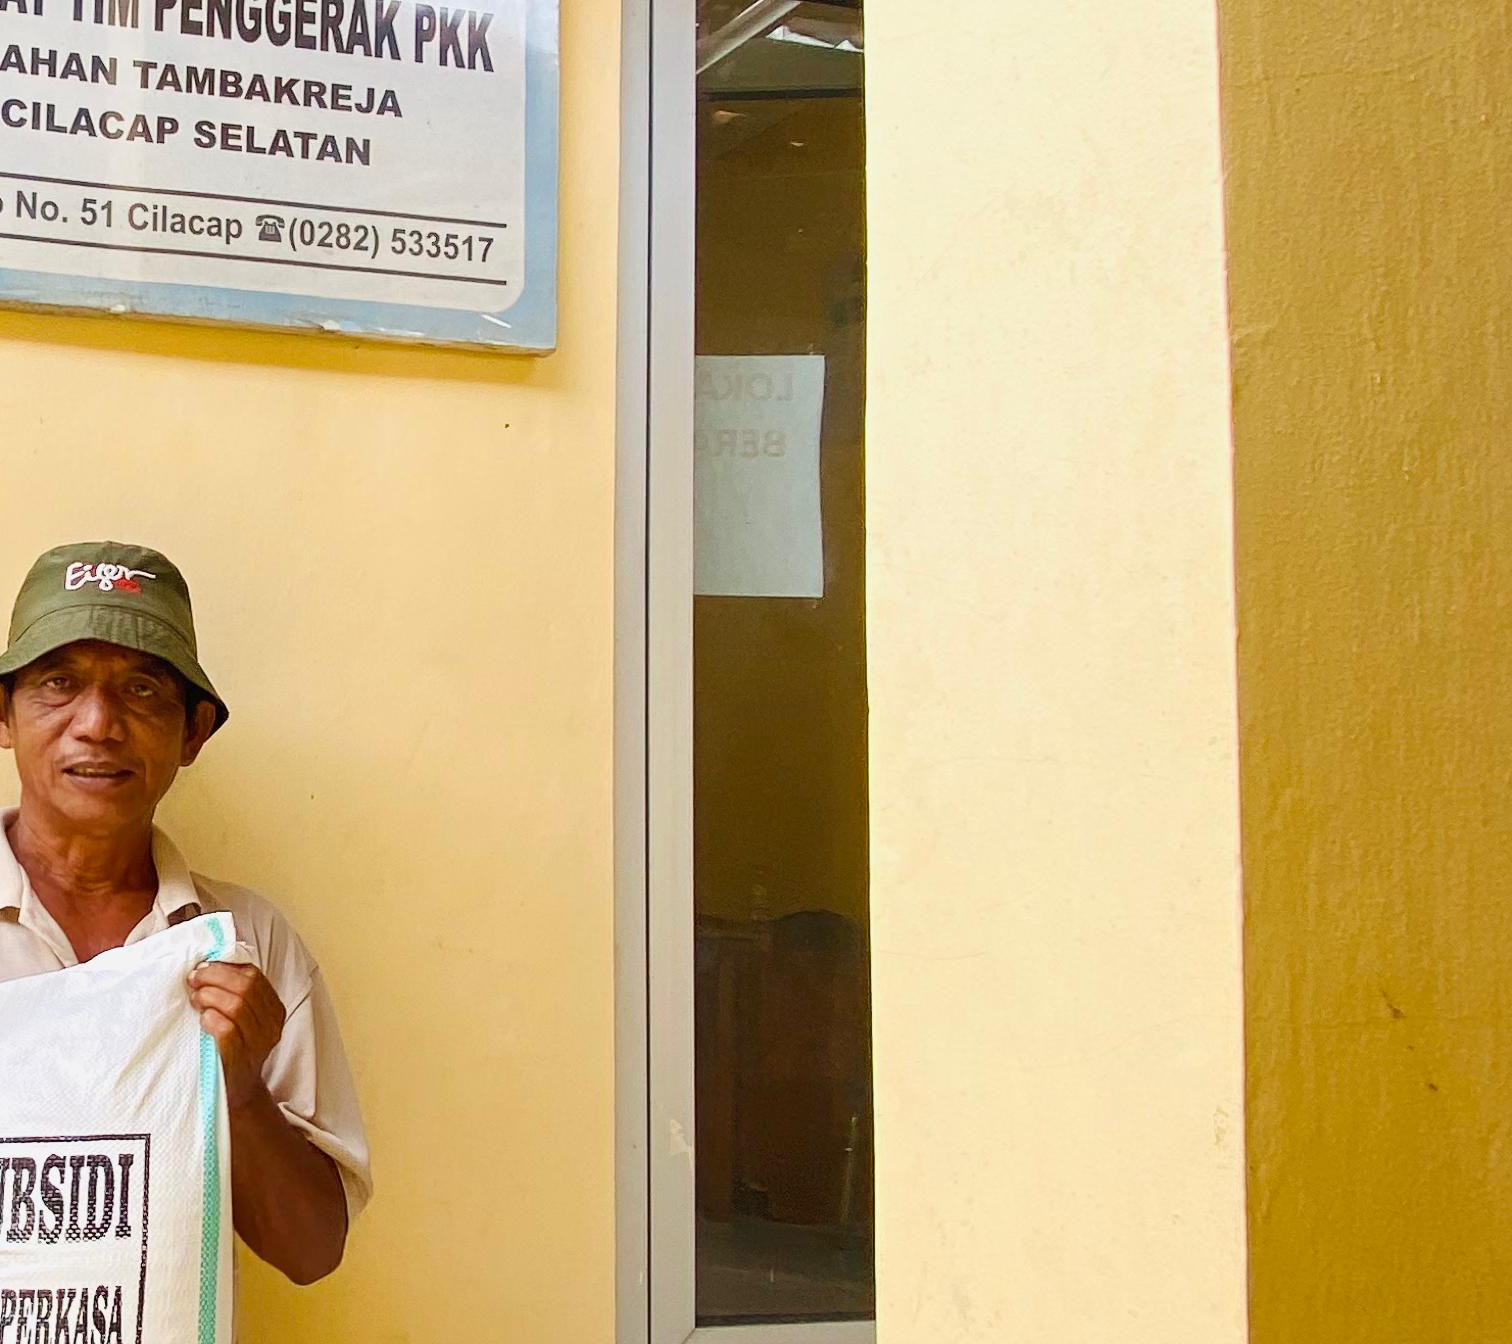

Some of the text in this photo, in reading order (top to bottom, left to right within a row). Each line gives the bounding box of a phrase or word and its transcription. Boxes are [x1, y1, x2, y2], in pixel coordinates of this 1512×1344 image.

[414, 3, 495, 72] PKK
[133, 60, 403, 118] TAMBAKREJA
[1, 99, 179, 144] CILACAP
[194, 120, 371, 166] SELATAN
[15, 190, 68, 223] No.
[80, 198, 113, 228] 51
[128, 203, 243, 244] Cilacap
[288, 217, 380, 259] (0282)
[390, 228, 494, 263] 533517
